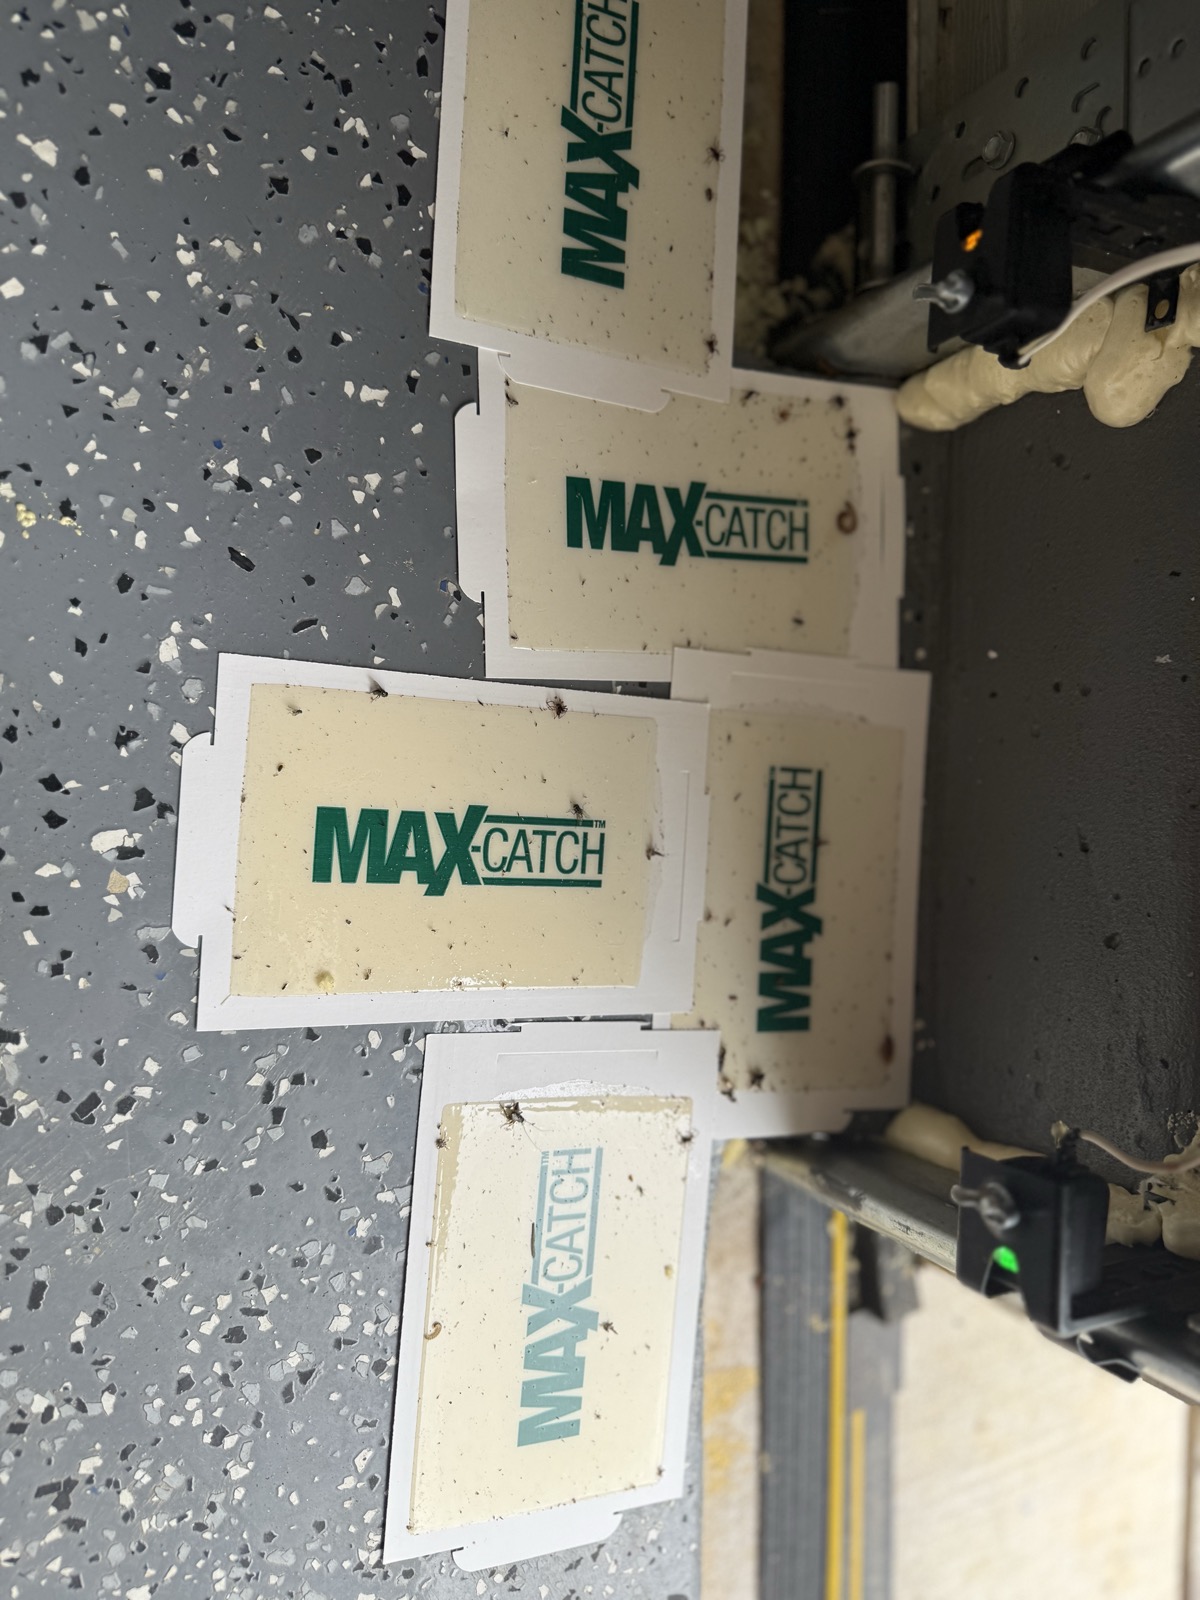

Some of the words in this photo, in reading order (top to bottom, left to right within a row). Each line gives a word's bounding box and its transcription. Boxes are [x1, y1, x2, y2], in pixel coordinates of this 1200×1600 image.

[565, 475, 809, 567] MAX-CATCH
[312, 804, 605, 896] MAX-CATCH
[756, 766, 824, 1033] MAX-CATCH
[517, 1147, 600, 1447] MAX-CATCH
